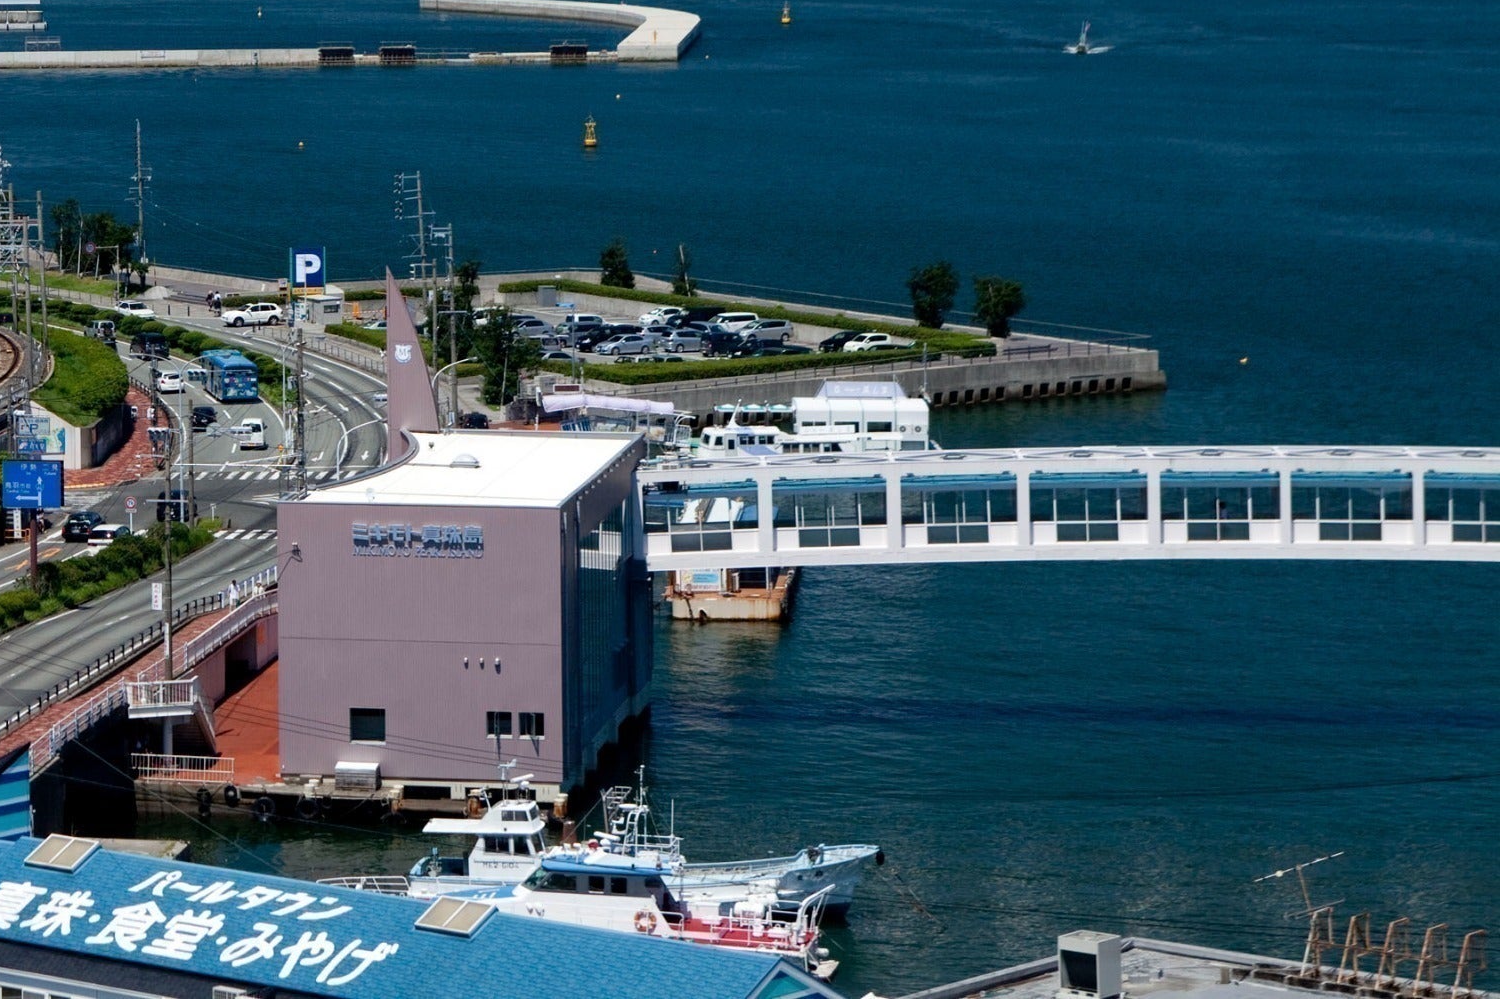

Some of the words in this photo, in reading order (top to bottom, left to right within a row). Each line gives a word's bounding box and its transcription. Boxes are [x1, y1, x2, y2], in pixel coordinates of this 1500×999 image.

[295, 253, 322, 283] P
[352, 522, 412, 543] ミキモト
[128, 870, 353, 921] パールタウン
